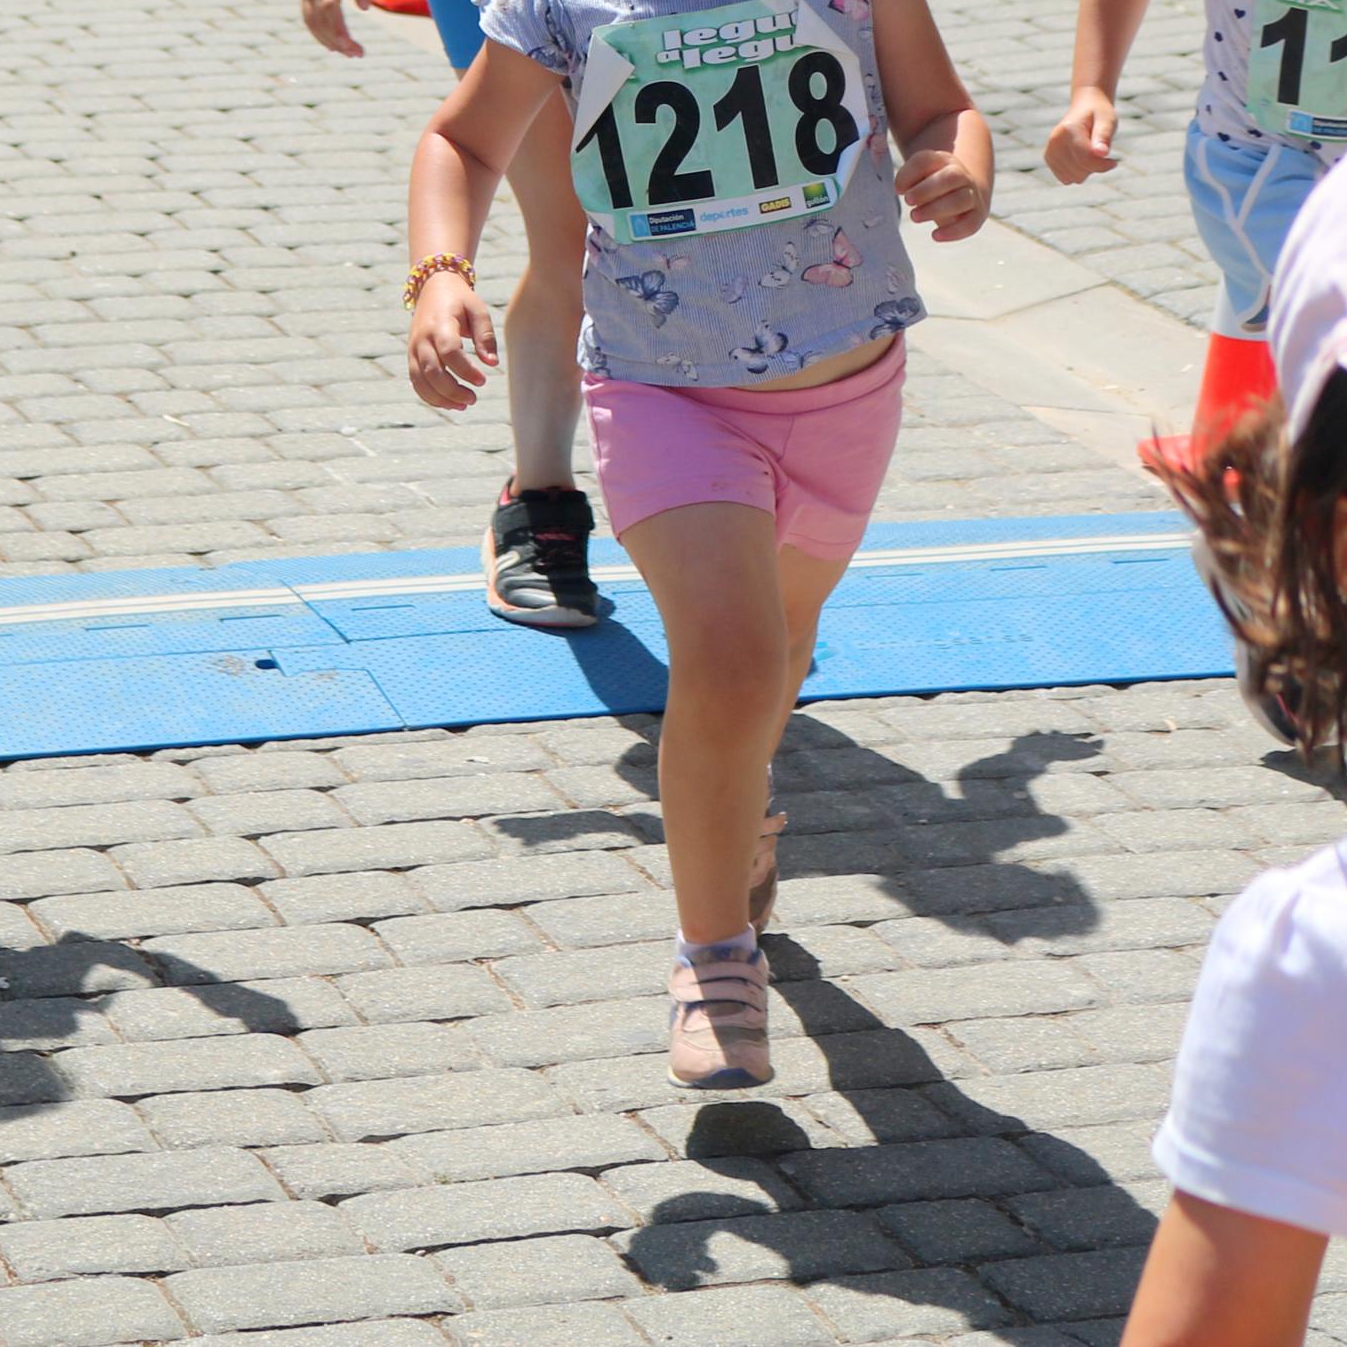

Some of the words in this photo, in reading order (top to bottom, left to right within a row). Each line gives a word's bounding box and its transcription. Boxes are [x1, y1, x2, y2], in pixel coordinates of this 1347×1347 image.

[663, 10, 798, 50] legu
[576, 51, 860, 209] 1218
[700, 206, 749, 223] deportes
